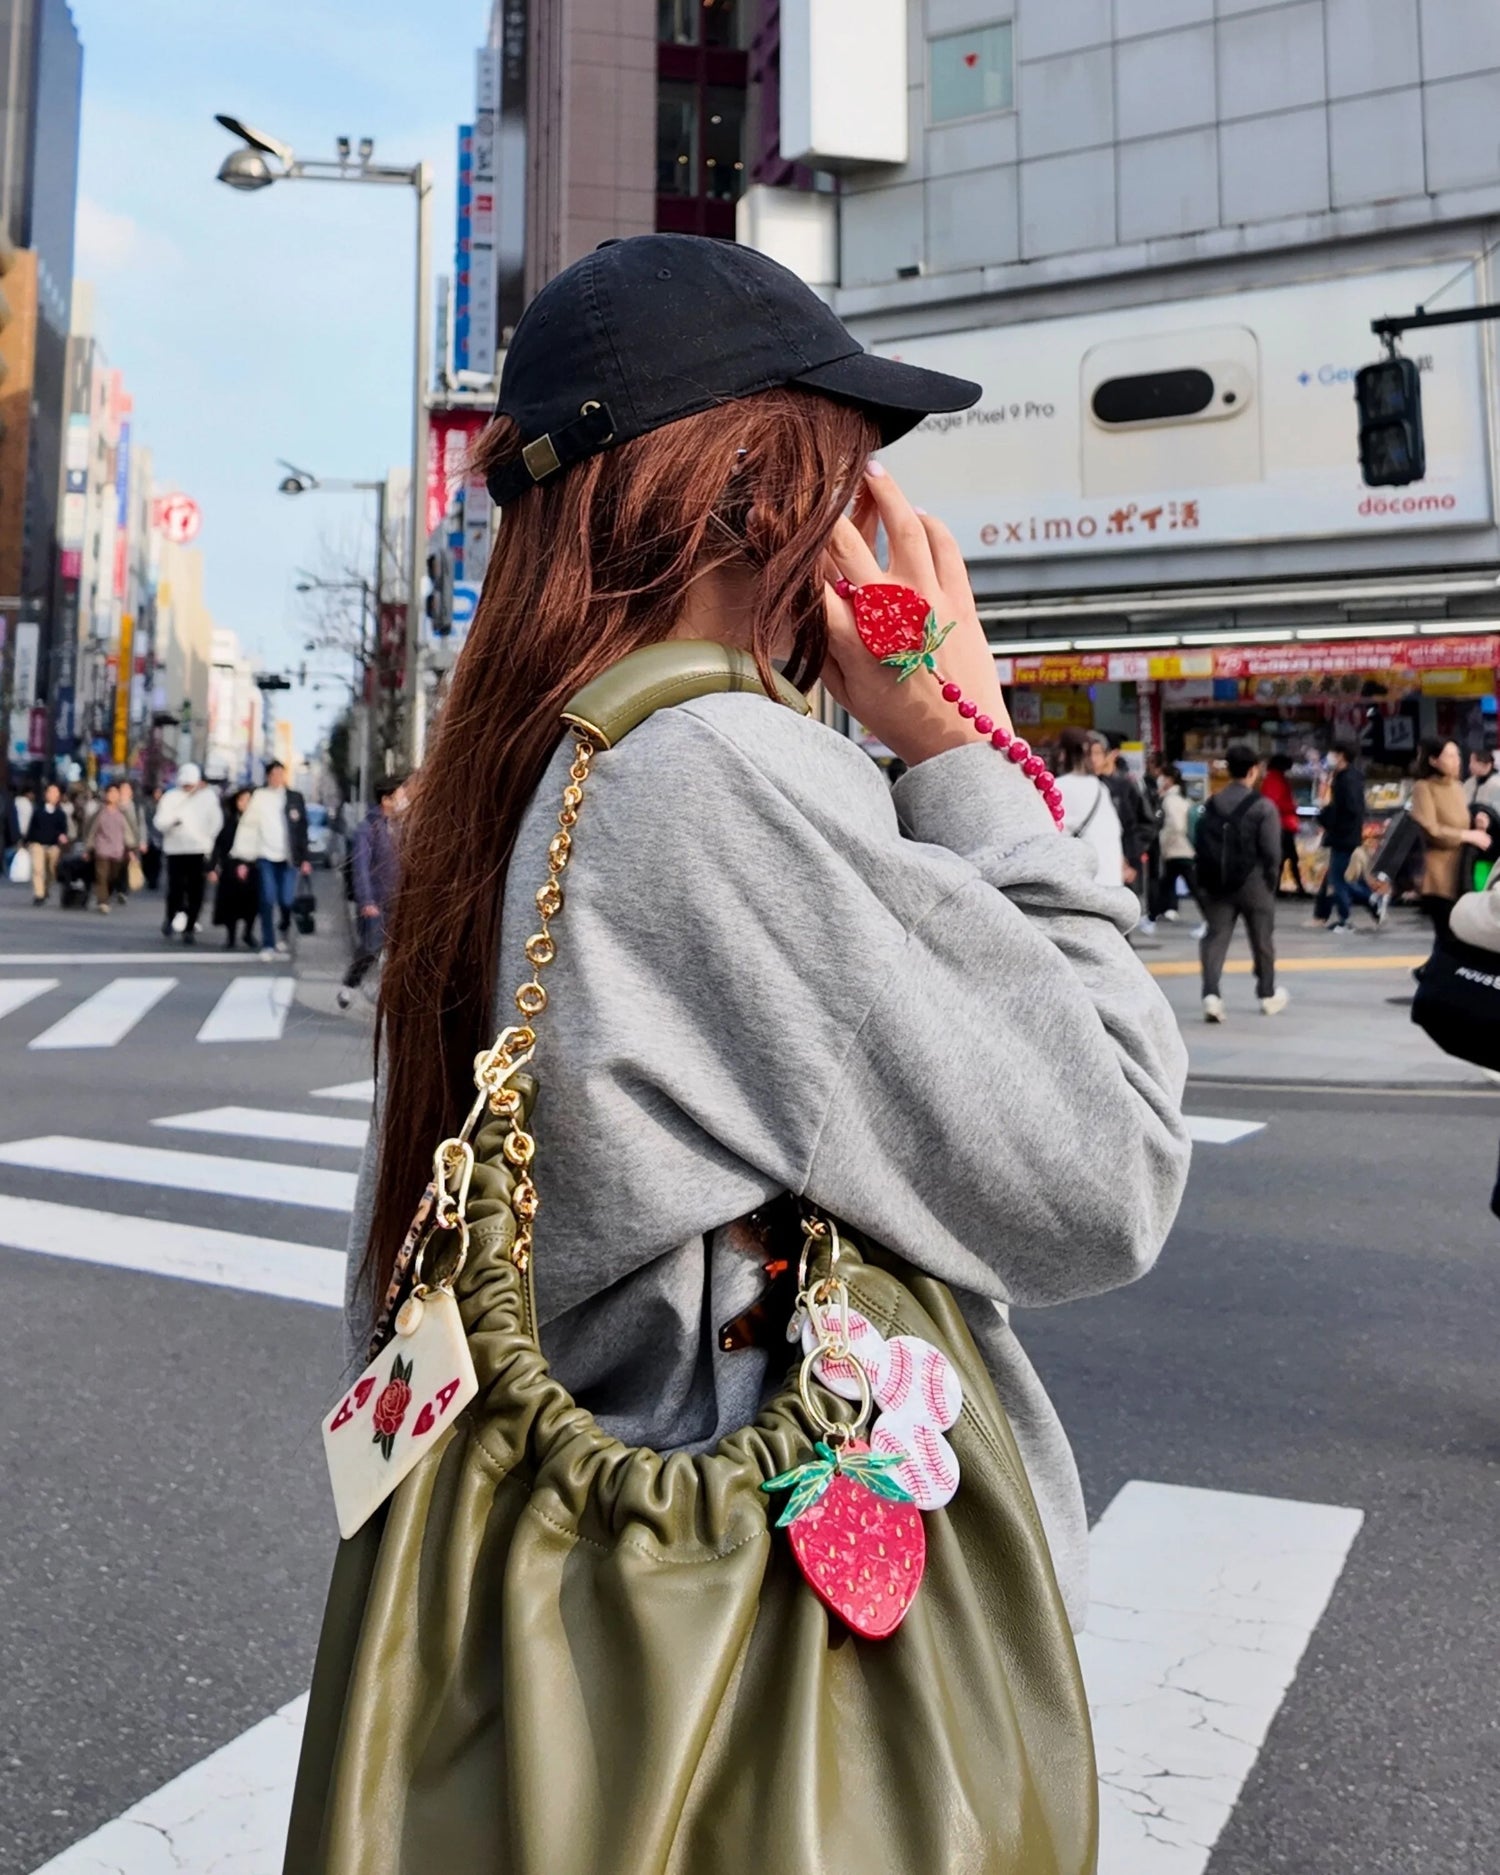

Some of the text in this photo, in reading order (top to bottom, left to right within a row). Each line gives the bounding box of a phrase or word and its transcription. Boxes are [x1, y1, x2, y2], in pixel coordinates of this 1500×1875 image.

[967, 405, 1005, 426] Pixel
[1009, 405, 1020, 419] 9
[1024, 402, 1055, 419] Pro
[980, 499, 1199, 546] eximo ポイ活
[1039, 666, 1067, 682] Free
[1070, 664, 1106, 681] Store
[436, 1378, 461, 1414] A
[330, 1397, 354, 1432] A
